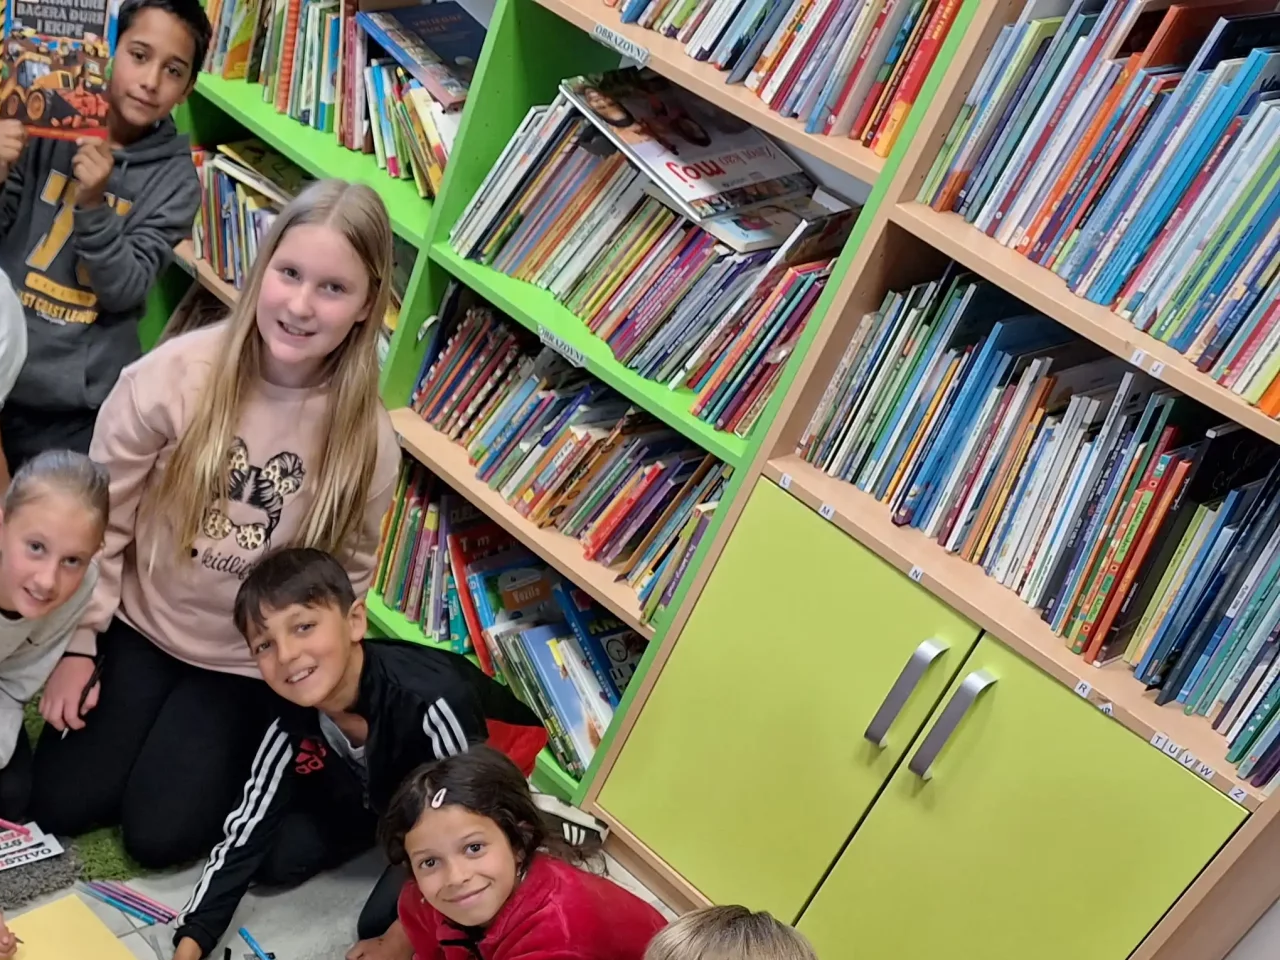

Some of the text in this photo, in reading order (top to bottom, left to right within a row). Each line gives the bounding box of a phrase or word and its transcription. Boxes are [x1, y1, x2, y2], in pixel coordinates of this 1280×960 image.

[17, 3, 67, 20] BAGERA
[36, 19, 84, 38] I EKIPE
[666, 160, 726, 189] moj
[202, 547, 254, 580] kidlif
